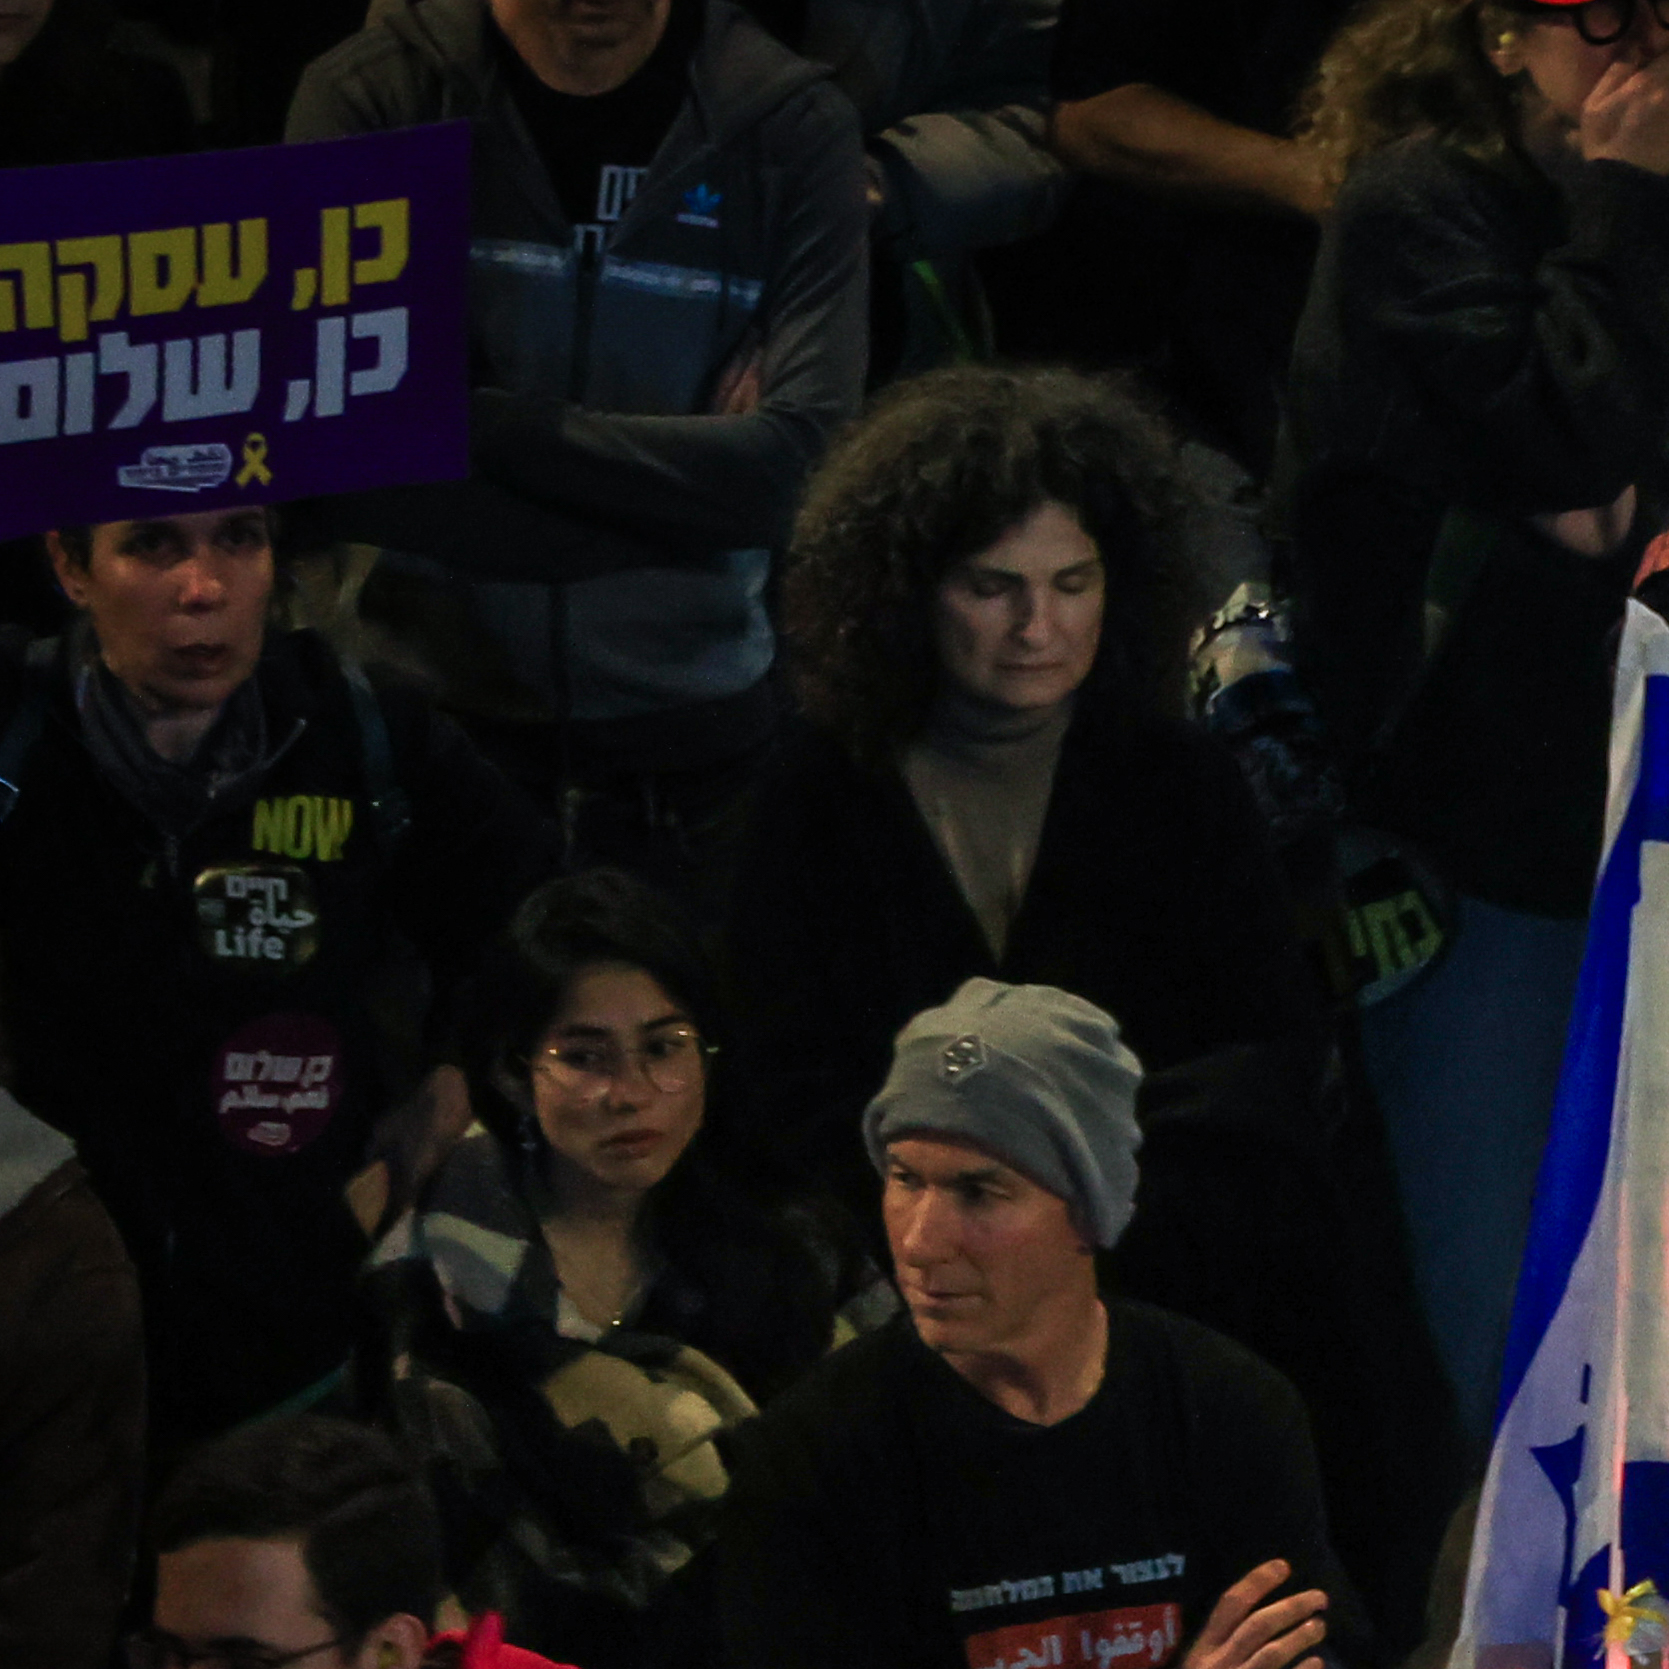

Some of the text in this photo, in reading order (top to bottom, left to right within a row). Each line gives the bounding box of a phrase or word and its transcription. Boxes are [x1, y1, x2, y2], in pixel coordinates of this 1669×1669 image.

[0, 196, 410, 343] כן, עסקה
[0, 305, 410, 445] כן, שלום
[213, 925, 287, 961] Life
